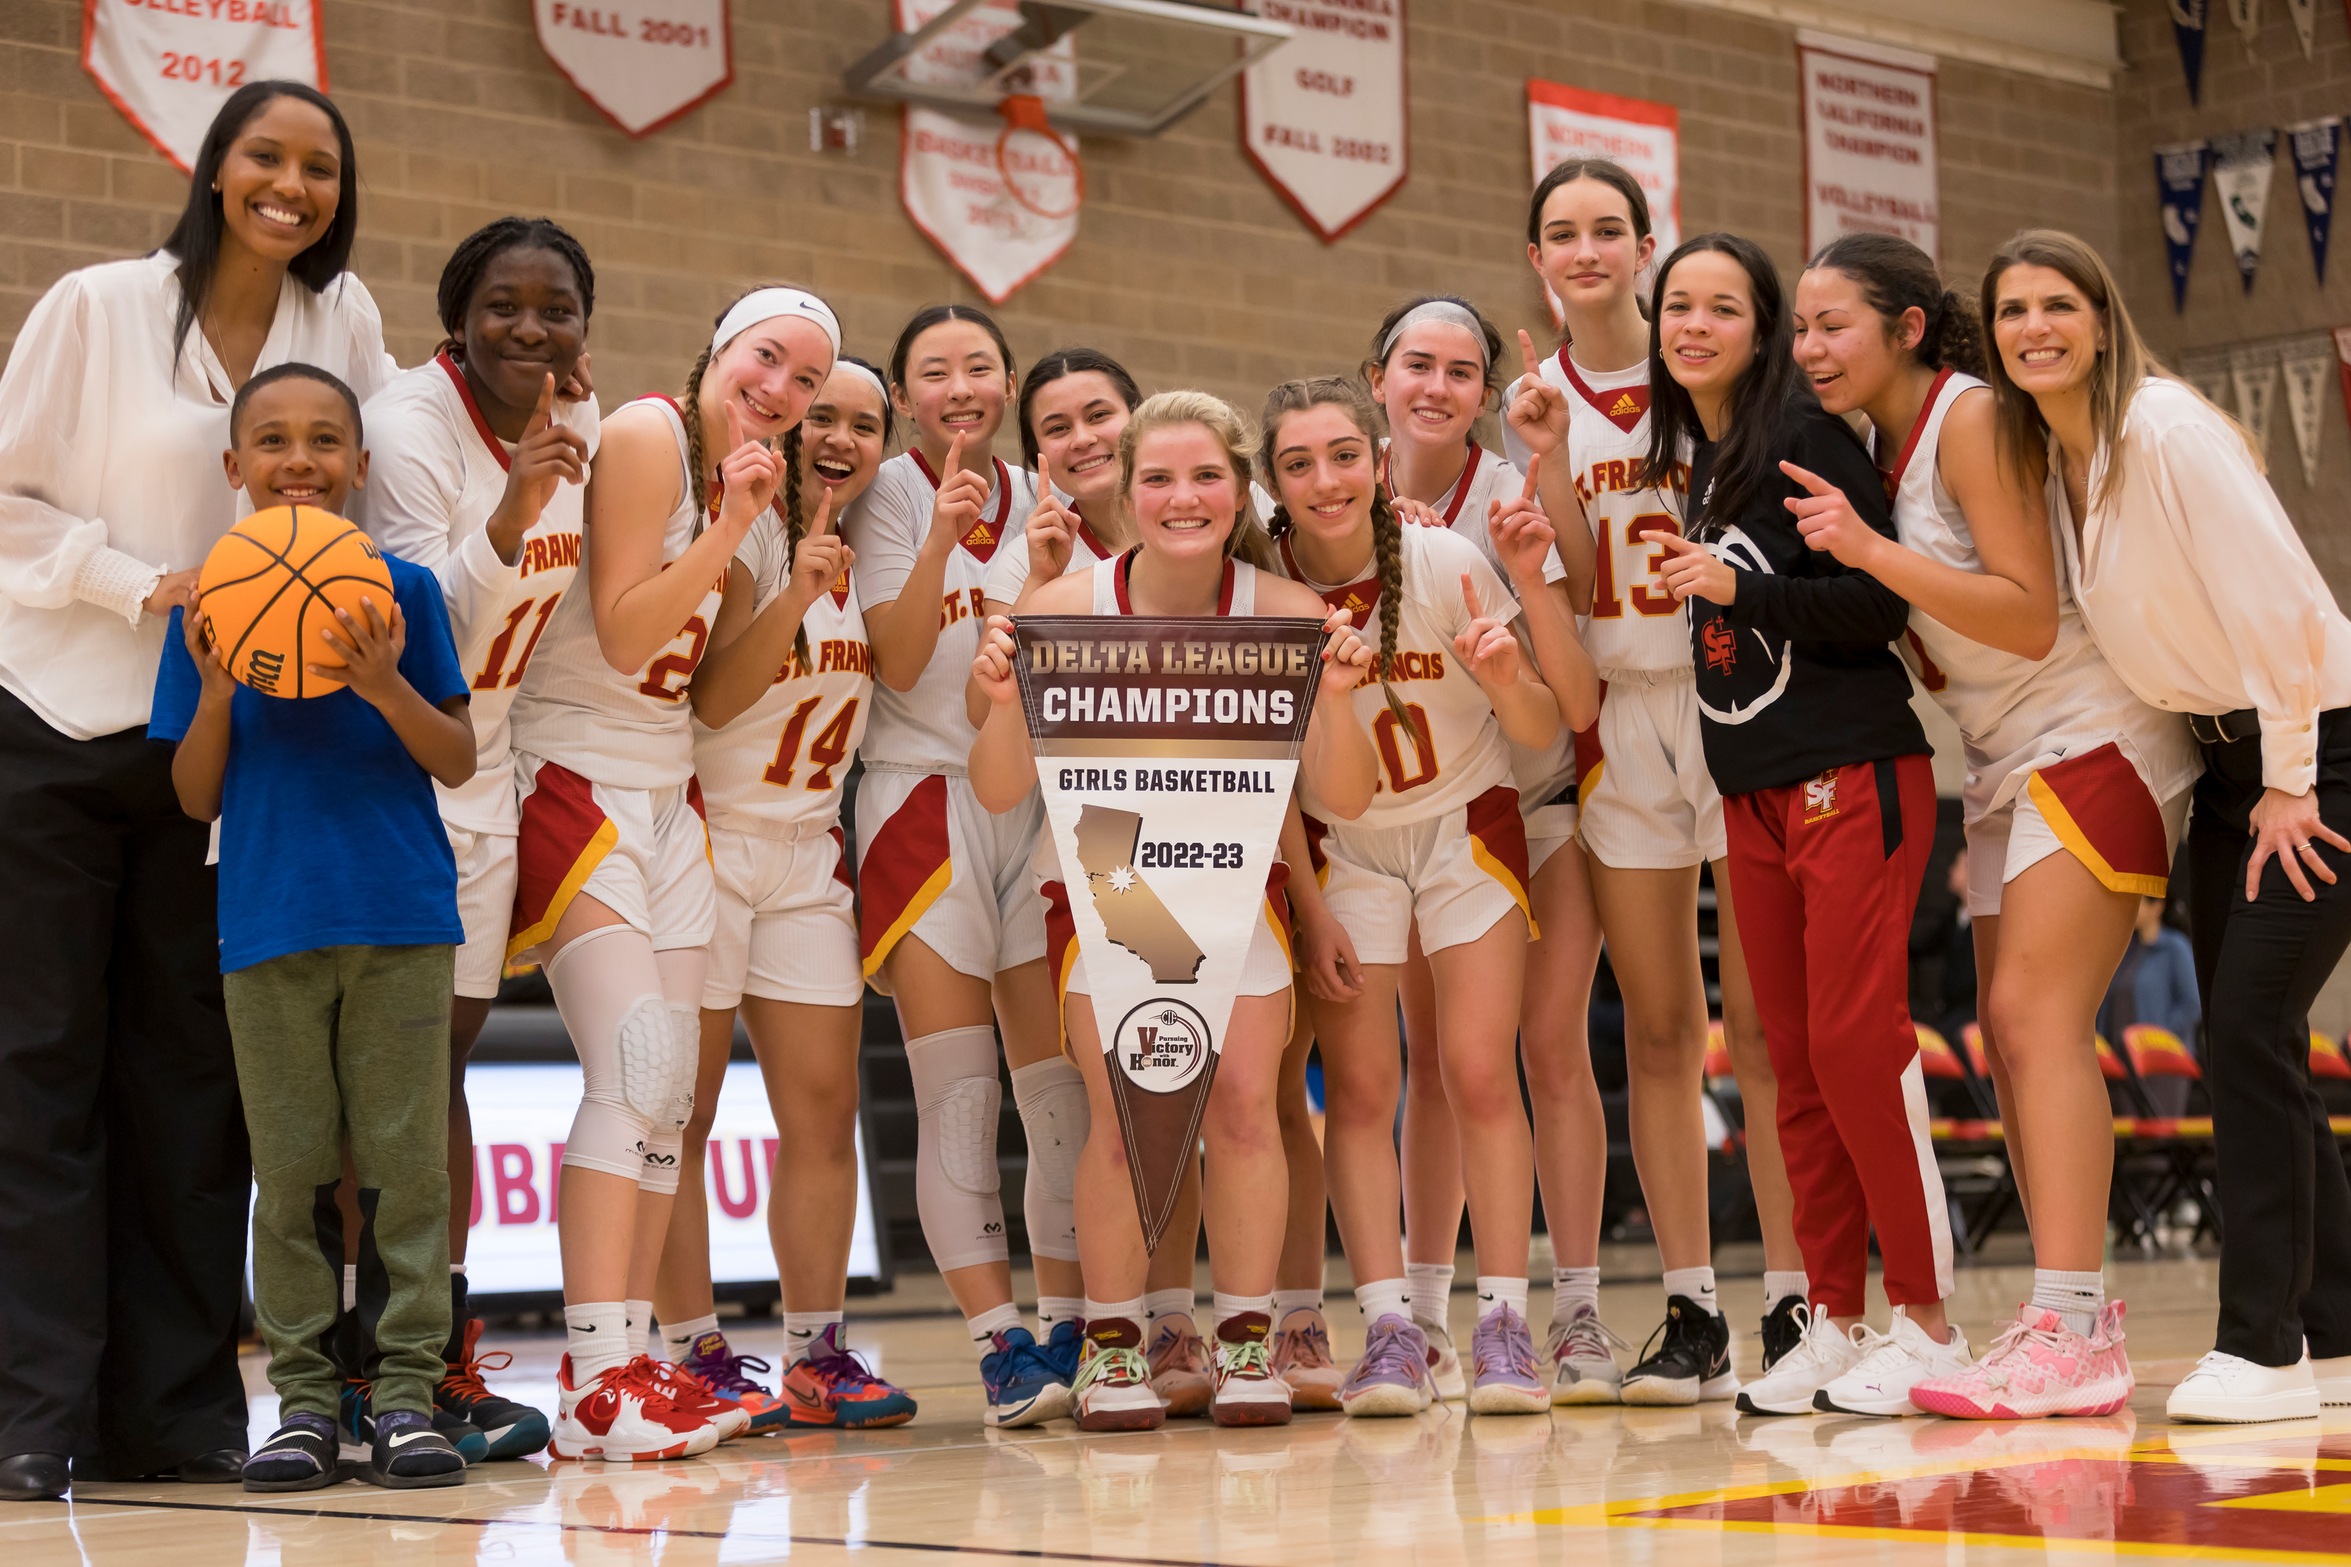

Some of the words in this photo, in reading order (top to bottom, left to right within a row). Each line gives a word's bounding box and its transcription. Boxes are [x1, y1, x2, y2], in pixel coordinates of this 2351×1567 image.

[123, 0, 299, 29] LEYBALL
[553, 2, 629, 38] FALL
[640, 17, 710, 48] 2001
[160, 52, 246, 87] 2012
[1295, 66, 1354, 97] GOLF
[1263, 122, 1321, 154] FALL
[1609, 404, 1641, 417] adidas
[520, 532, 582, 580] FRANC
[966, 537, 995, 546] adidas
[1592, 512, 1686, 620] 13
[470, 590, 562, 691] 11
[1030, 640, 1151, 675] DELTA
[1161, 641, 1309, 677] LEAGUE
[1042, 687, 1295, 725] CHAMPIONS
[762, 695, 860, 791] 14
[1059, 768, 1128, 791] GIRLS
[1135, 769, 1275, 793] BASKETBALL
[1141, 841, 1244, 869] 2022-23
[1137, 1026, 1194, 1056] Victory
